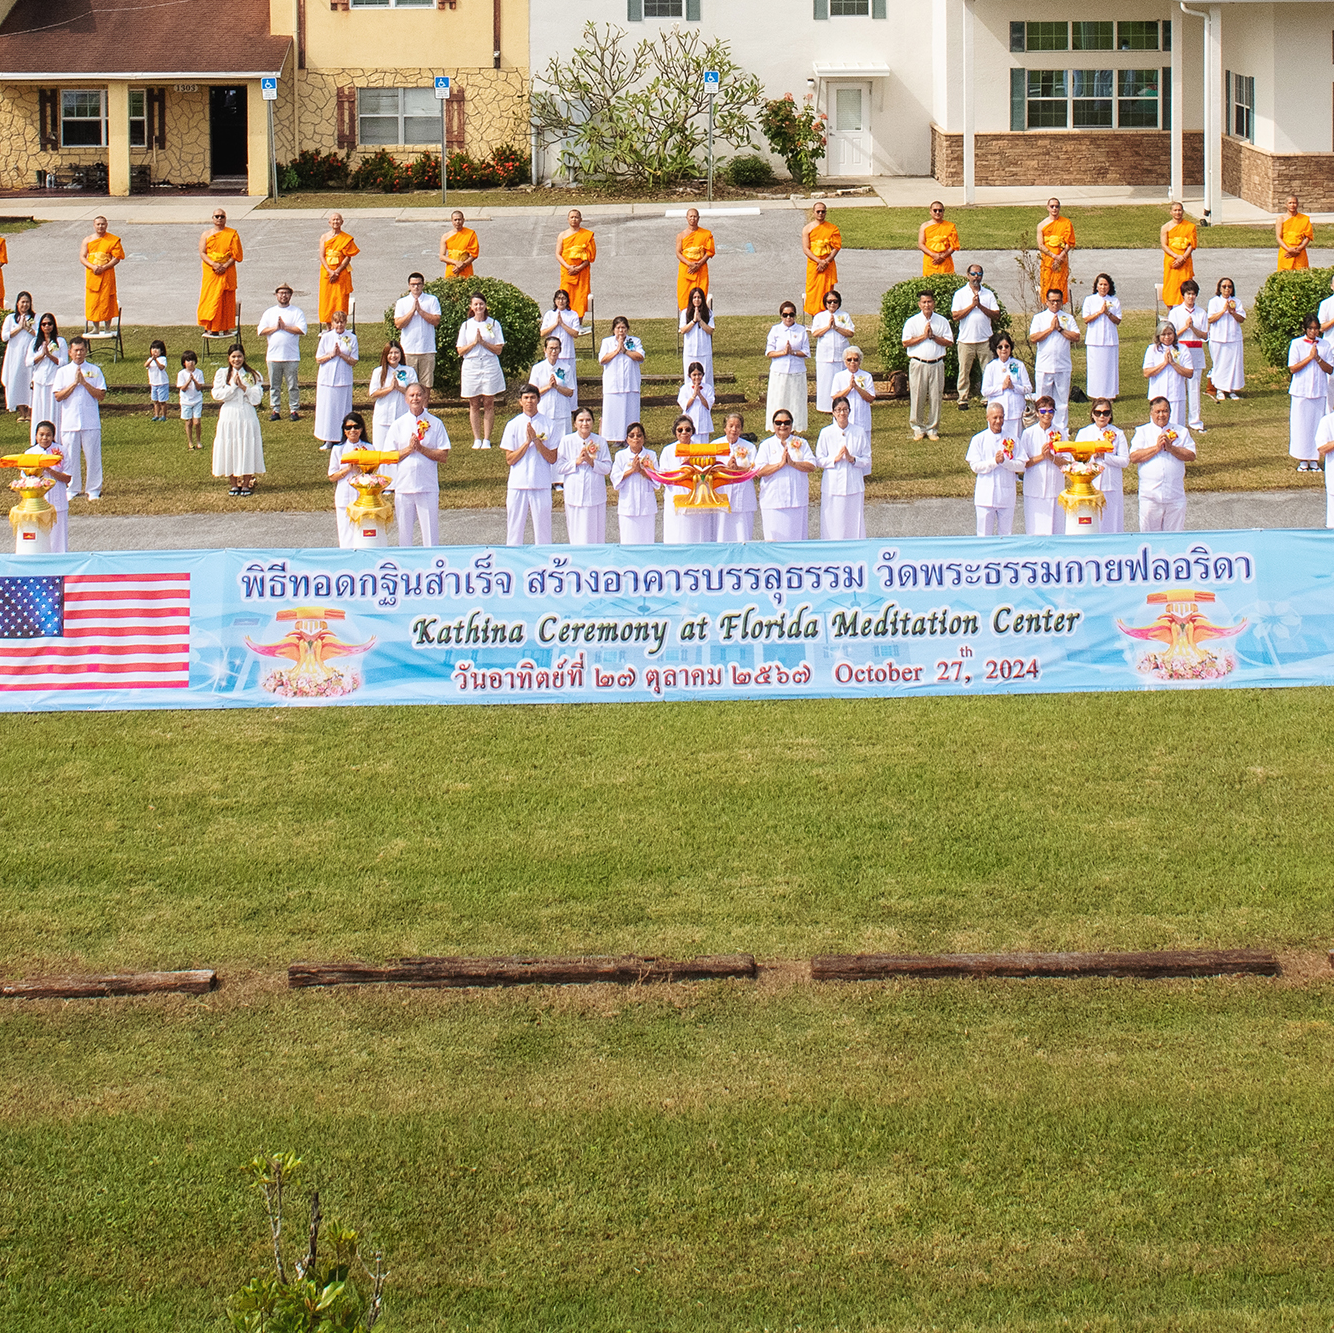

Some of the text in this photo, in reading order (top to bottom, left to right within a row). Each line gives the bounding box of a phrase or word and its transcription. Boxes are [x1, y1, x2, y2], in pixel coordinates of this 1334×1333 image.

[241, 546, 1251, 606] พิธีทอดกฐินสำเร็จ สร้างอาคารบรรลุธรรม วัดพระธรรมกายฟลอริดา
[413, 604, 1080, 654] Kathina Ceremony at Florida Meditation Center
[454, 652, 811, 694] วันอาทิตย์ที่ ๒๗ ตุลาคม ๒๕๖๗
[834, 662, 922, 684] October
[985, 659, 1039, 680] 2024
